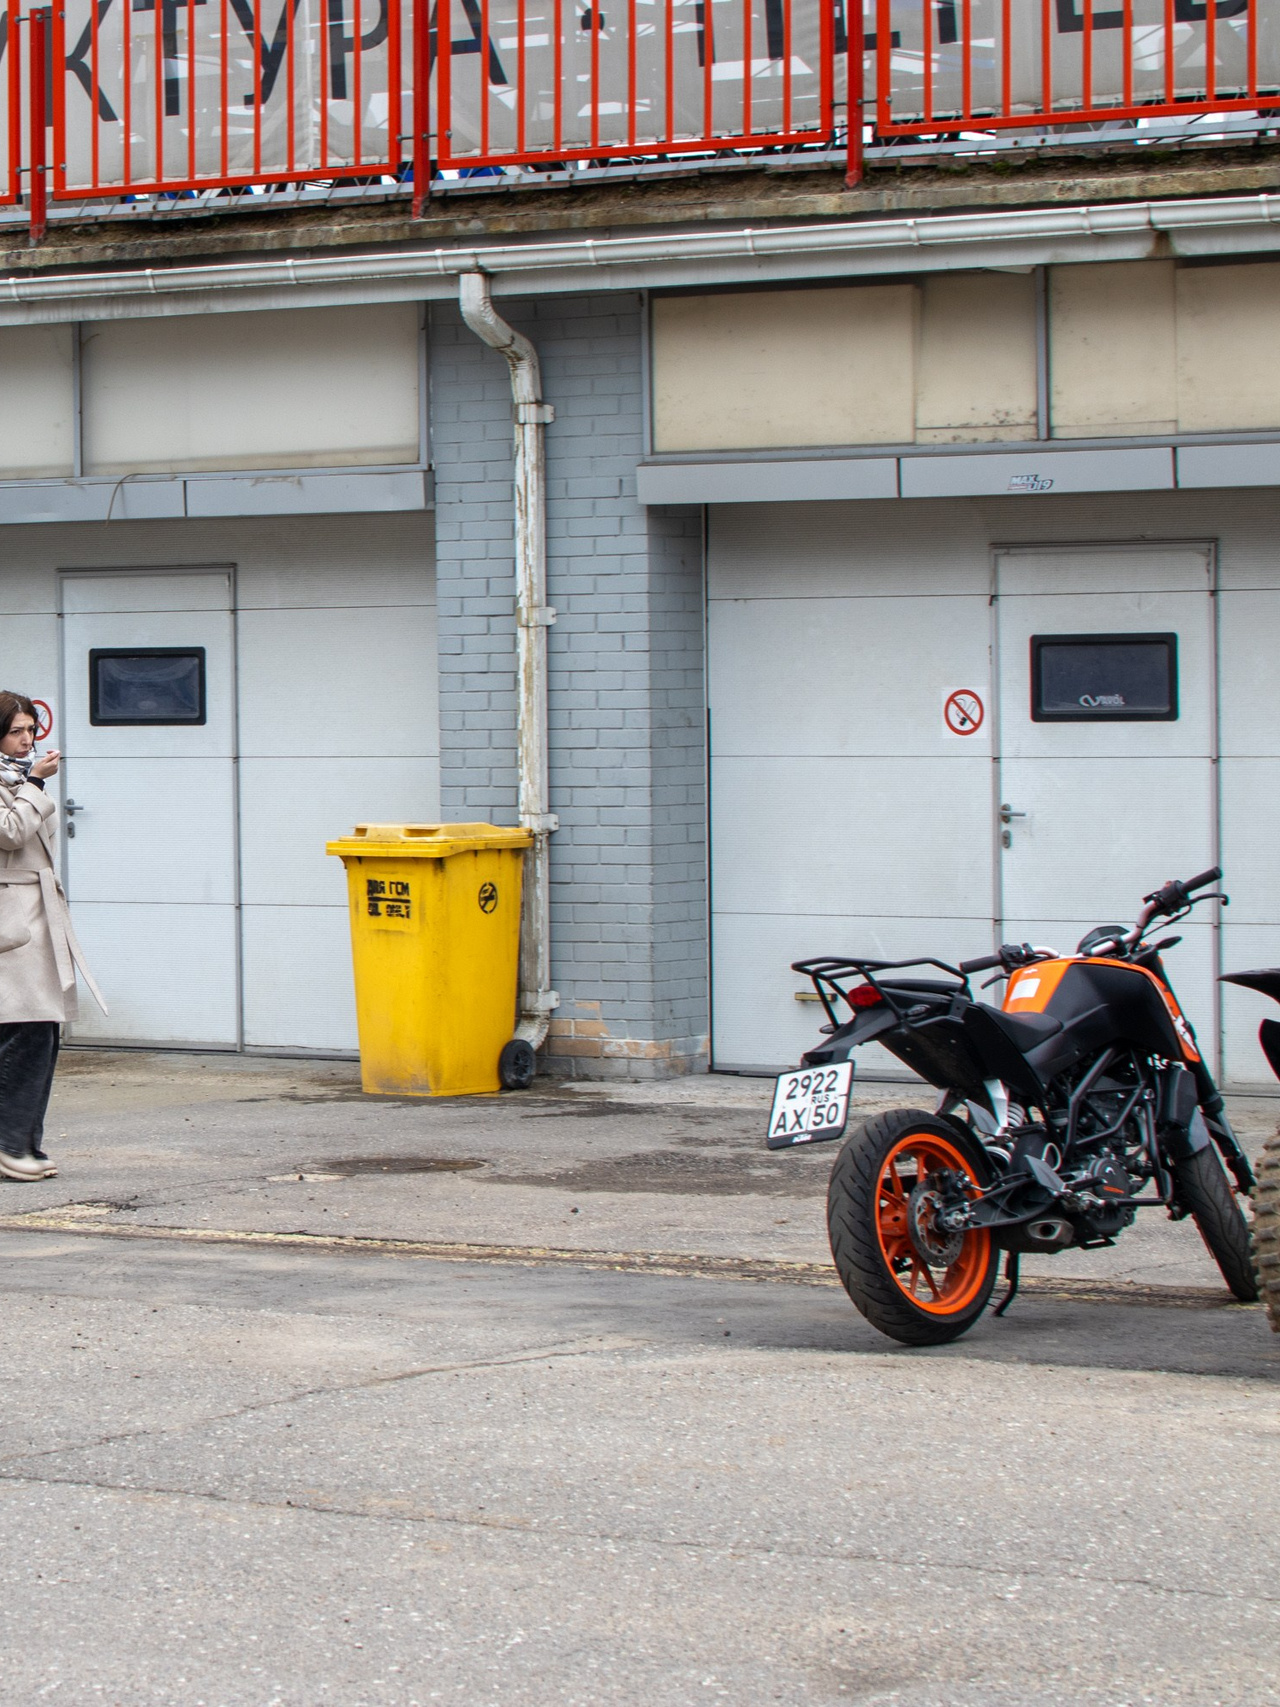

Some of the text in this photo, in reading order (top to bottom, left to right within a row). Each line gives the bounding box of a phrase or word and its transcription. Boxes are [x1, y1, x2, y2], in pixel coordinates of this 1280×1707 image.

[389, 881, 409, 896] ГСМ
[786, 1070, 838, 1099] 2922
[811, 1094, 829, 1103] RUS
[812, 1103, 838, 1126] 50
